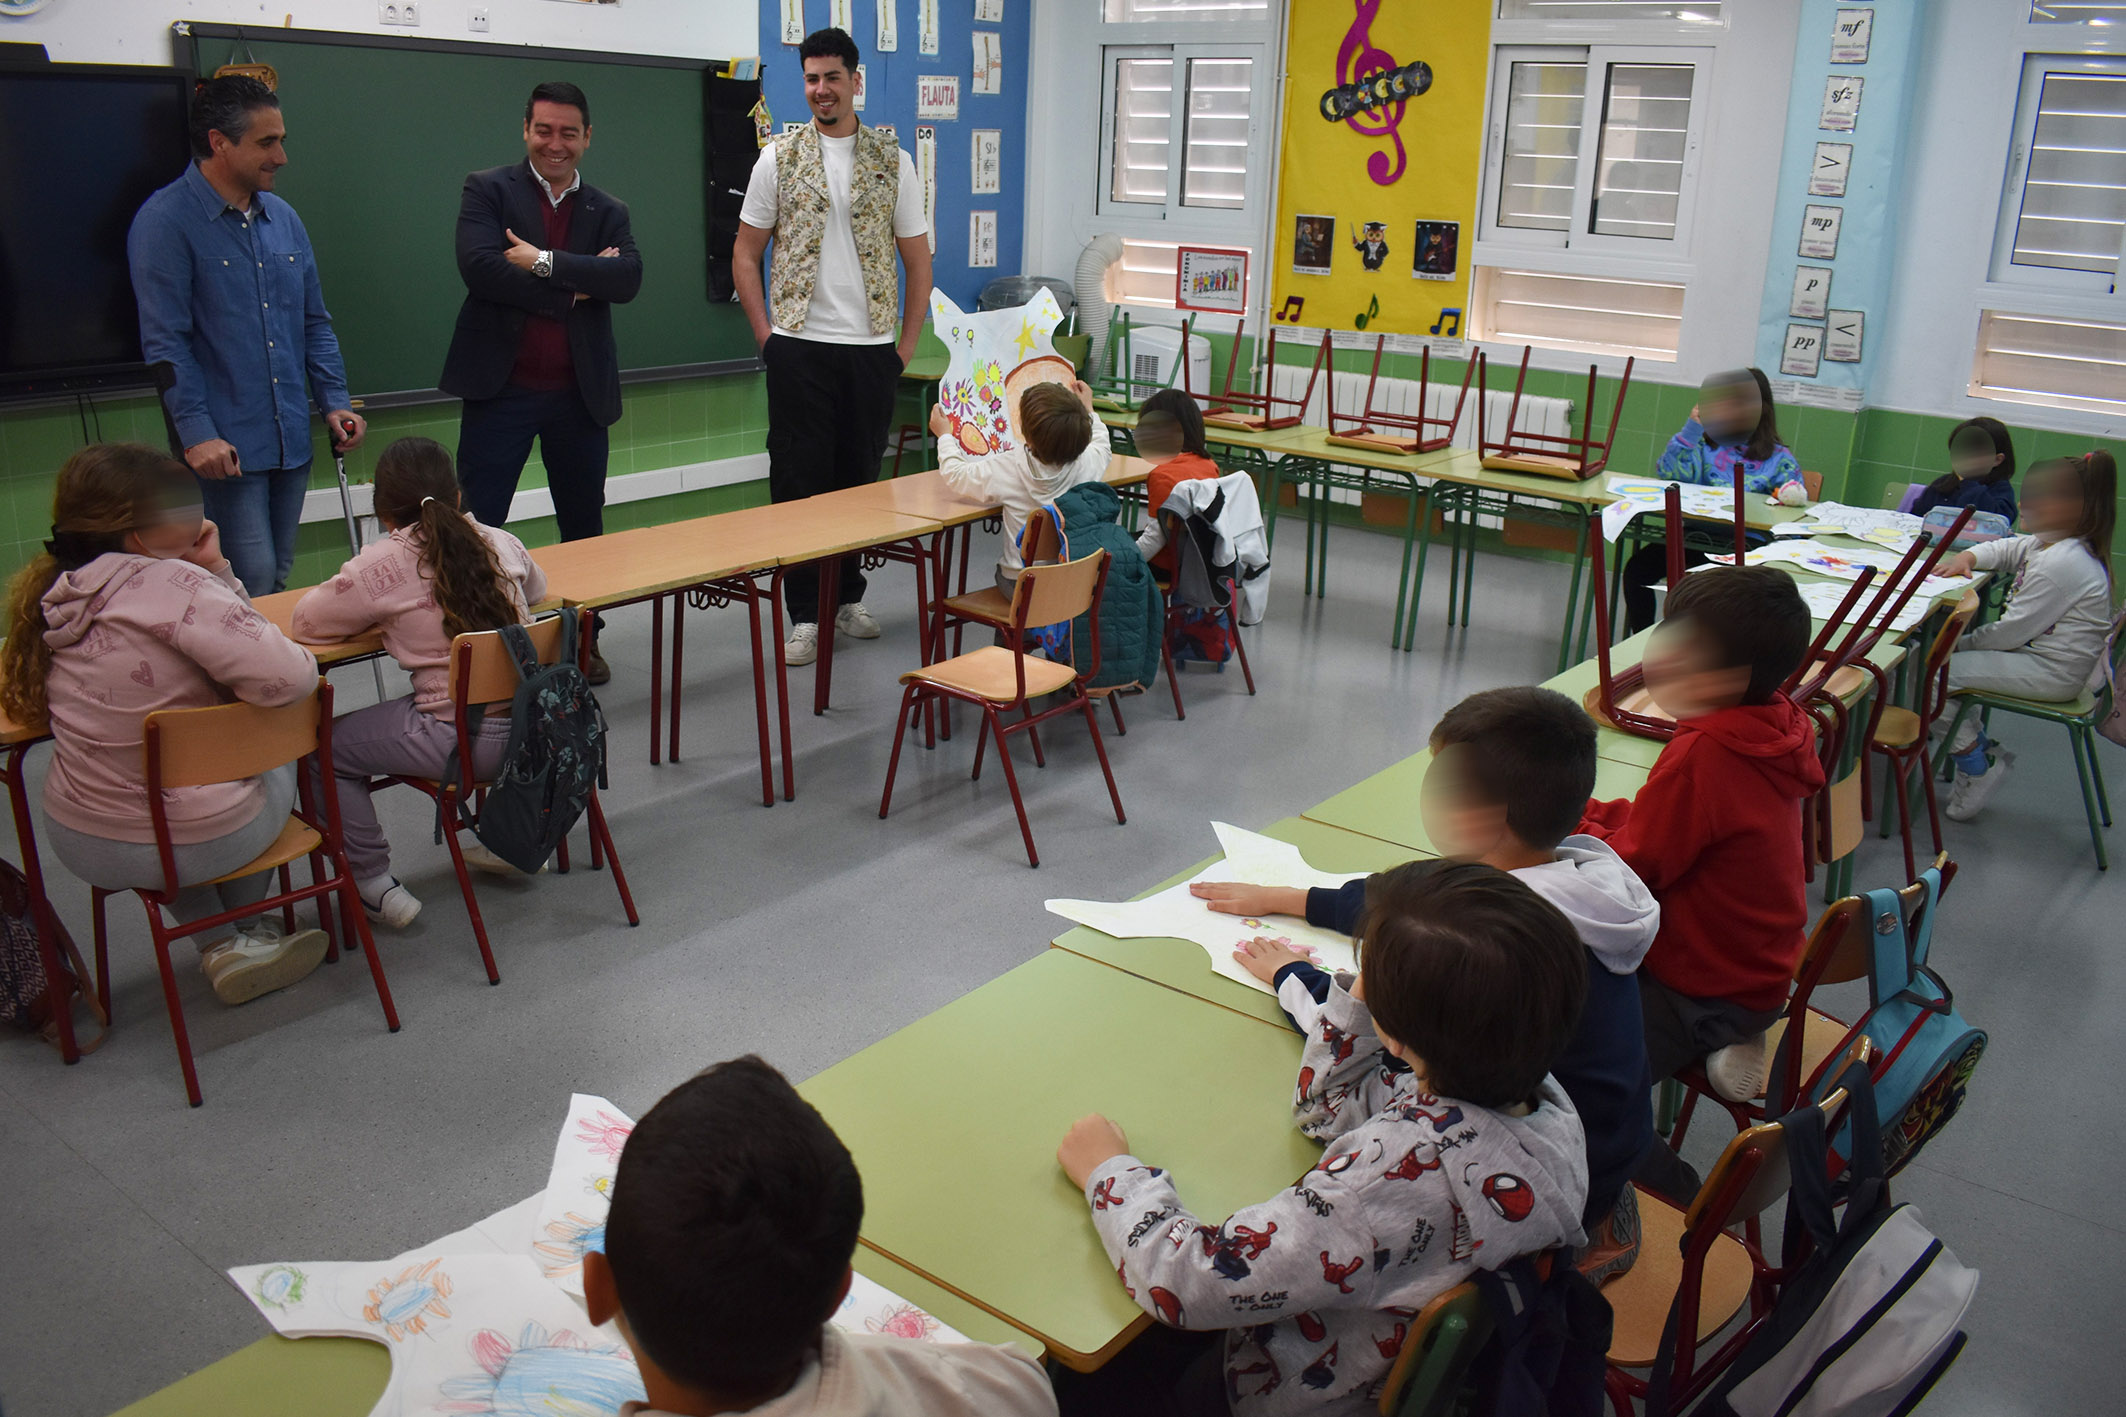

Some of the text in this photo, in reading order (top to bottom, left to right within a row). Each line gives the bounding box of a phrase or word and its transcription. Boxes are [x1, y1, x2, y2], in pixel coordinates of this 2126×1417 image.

[1840, 19, 1864, 37] mf
[921, 85, 955, 106] FLAUTA
[1831, 86, 1854, 104] sfz
[918, 128, 932, 139] DO
[1810, 217, 1833, 232] mp
[1805, 278, 1819, 292] p
[1791, 336, 1816, 351] pp
[1397, 1217, 1427, 1268] THE ONE
[1417, 1224, 1436, 1254] ONLY
[1229, 1290, 1289, 1305] THE ONE
[1249, 1301, 1284, 1311] ONLY
